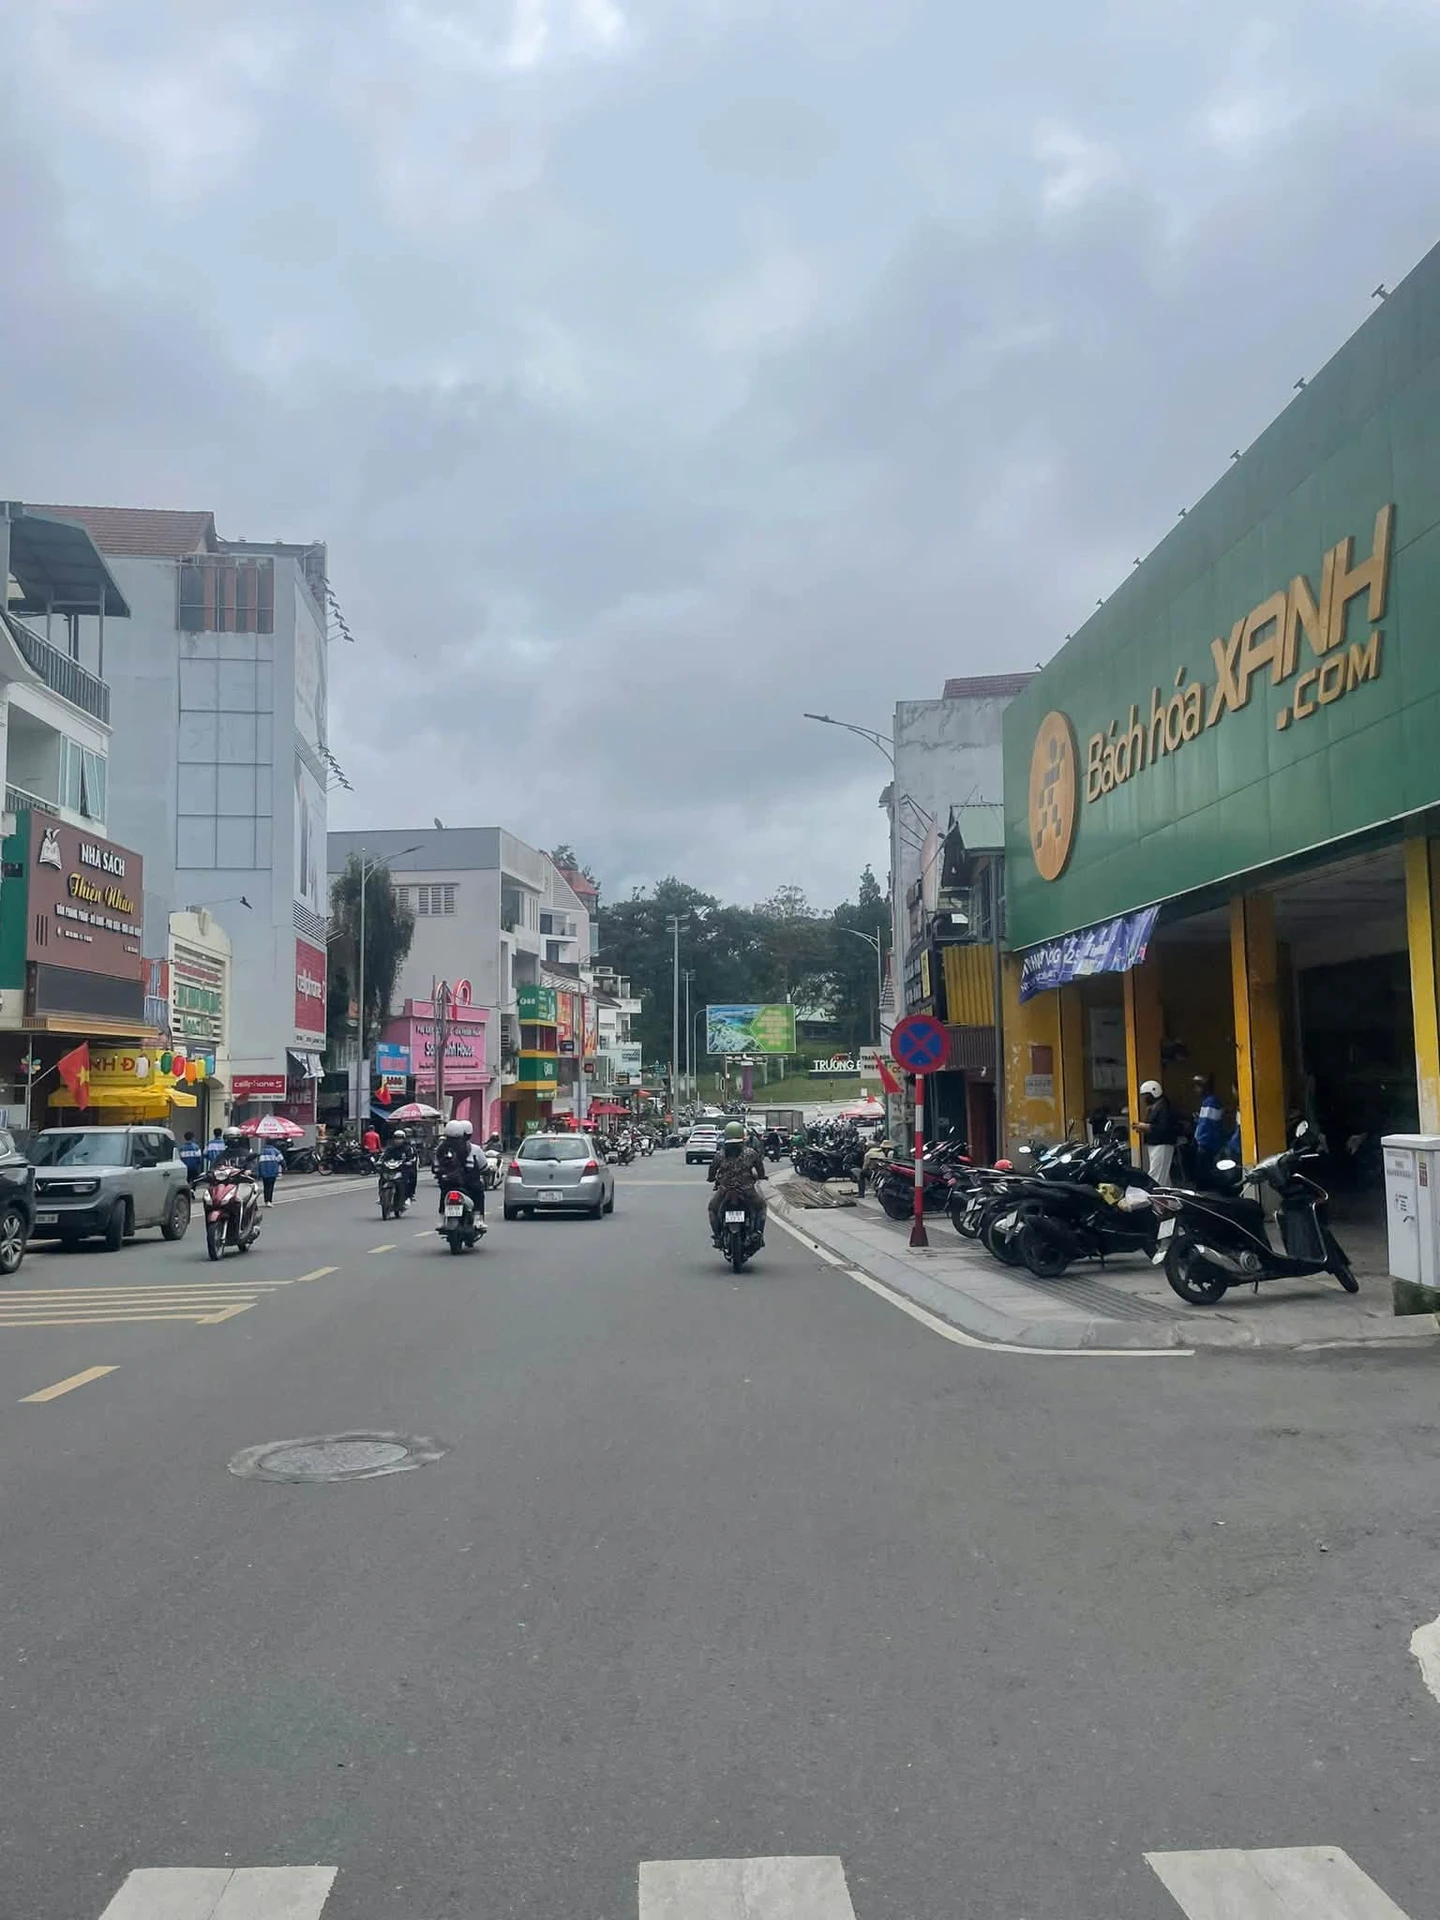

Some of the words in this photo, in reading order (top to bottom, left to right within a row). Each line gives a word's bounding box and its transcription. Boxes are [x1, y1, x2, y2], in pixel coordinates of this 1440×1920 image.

[1086, 704, 1145, 804] Bách
[1149, 665, 1206, 765] hóa
[1205, 502, 1395, 729] XANH
[81, 842, 102, 869] NHÀ
[102, 850, 125, 877] SÁCH
